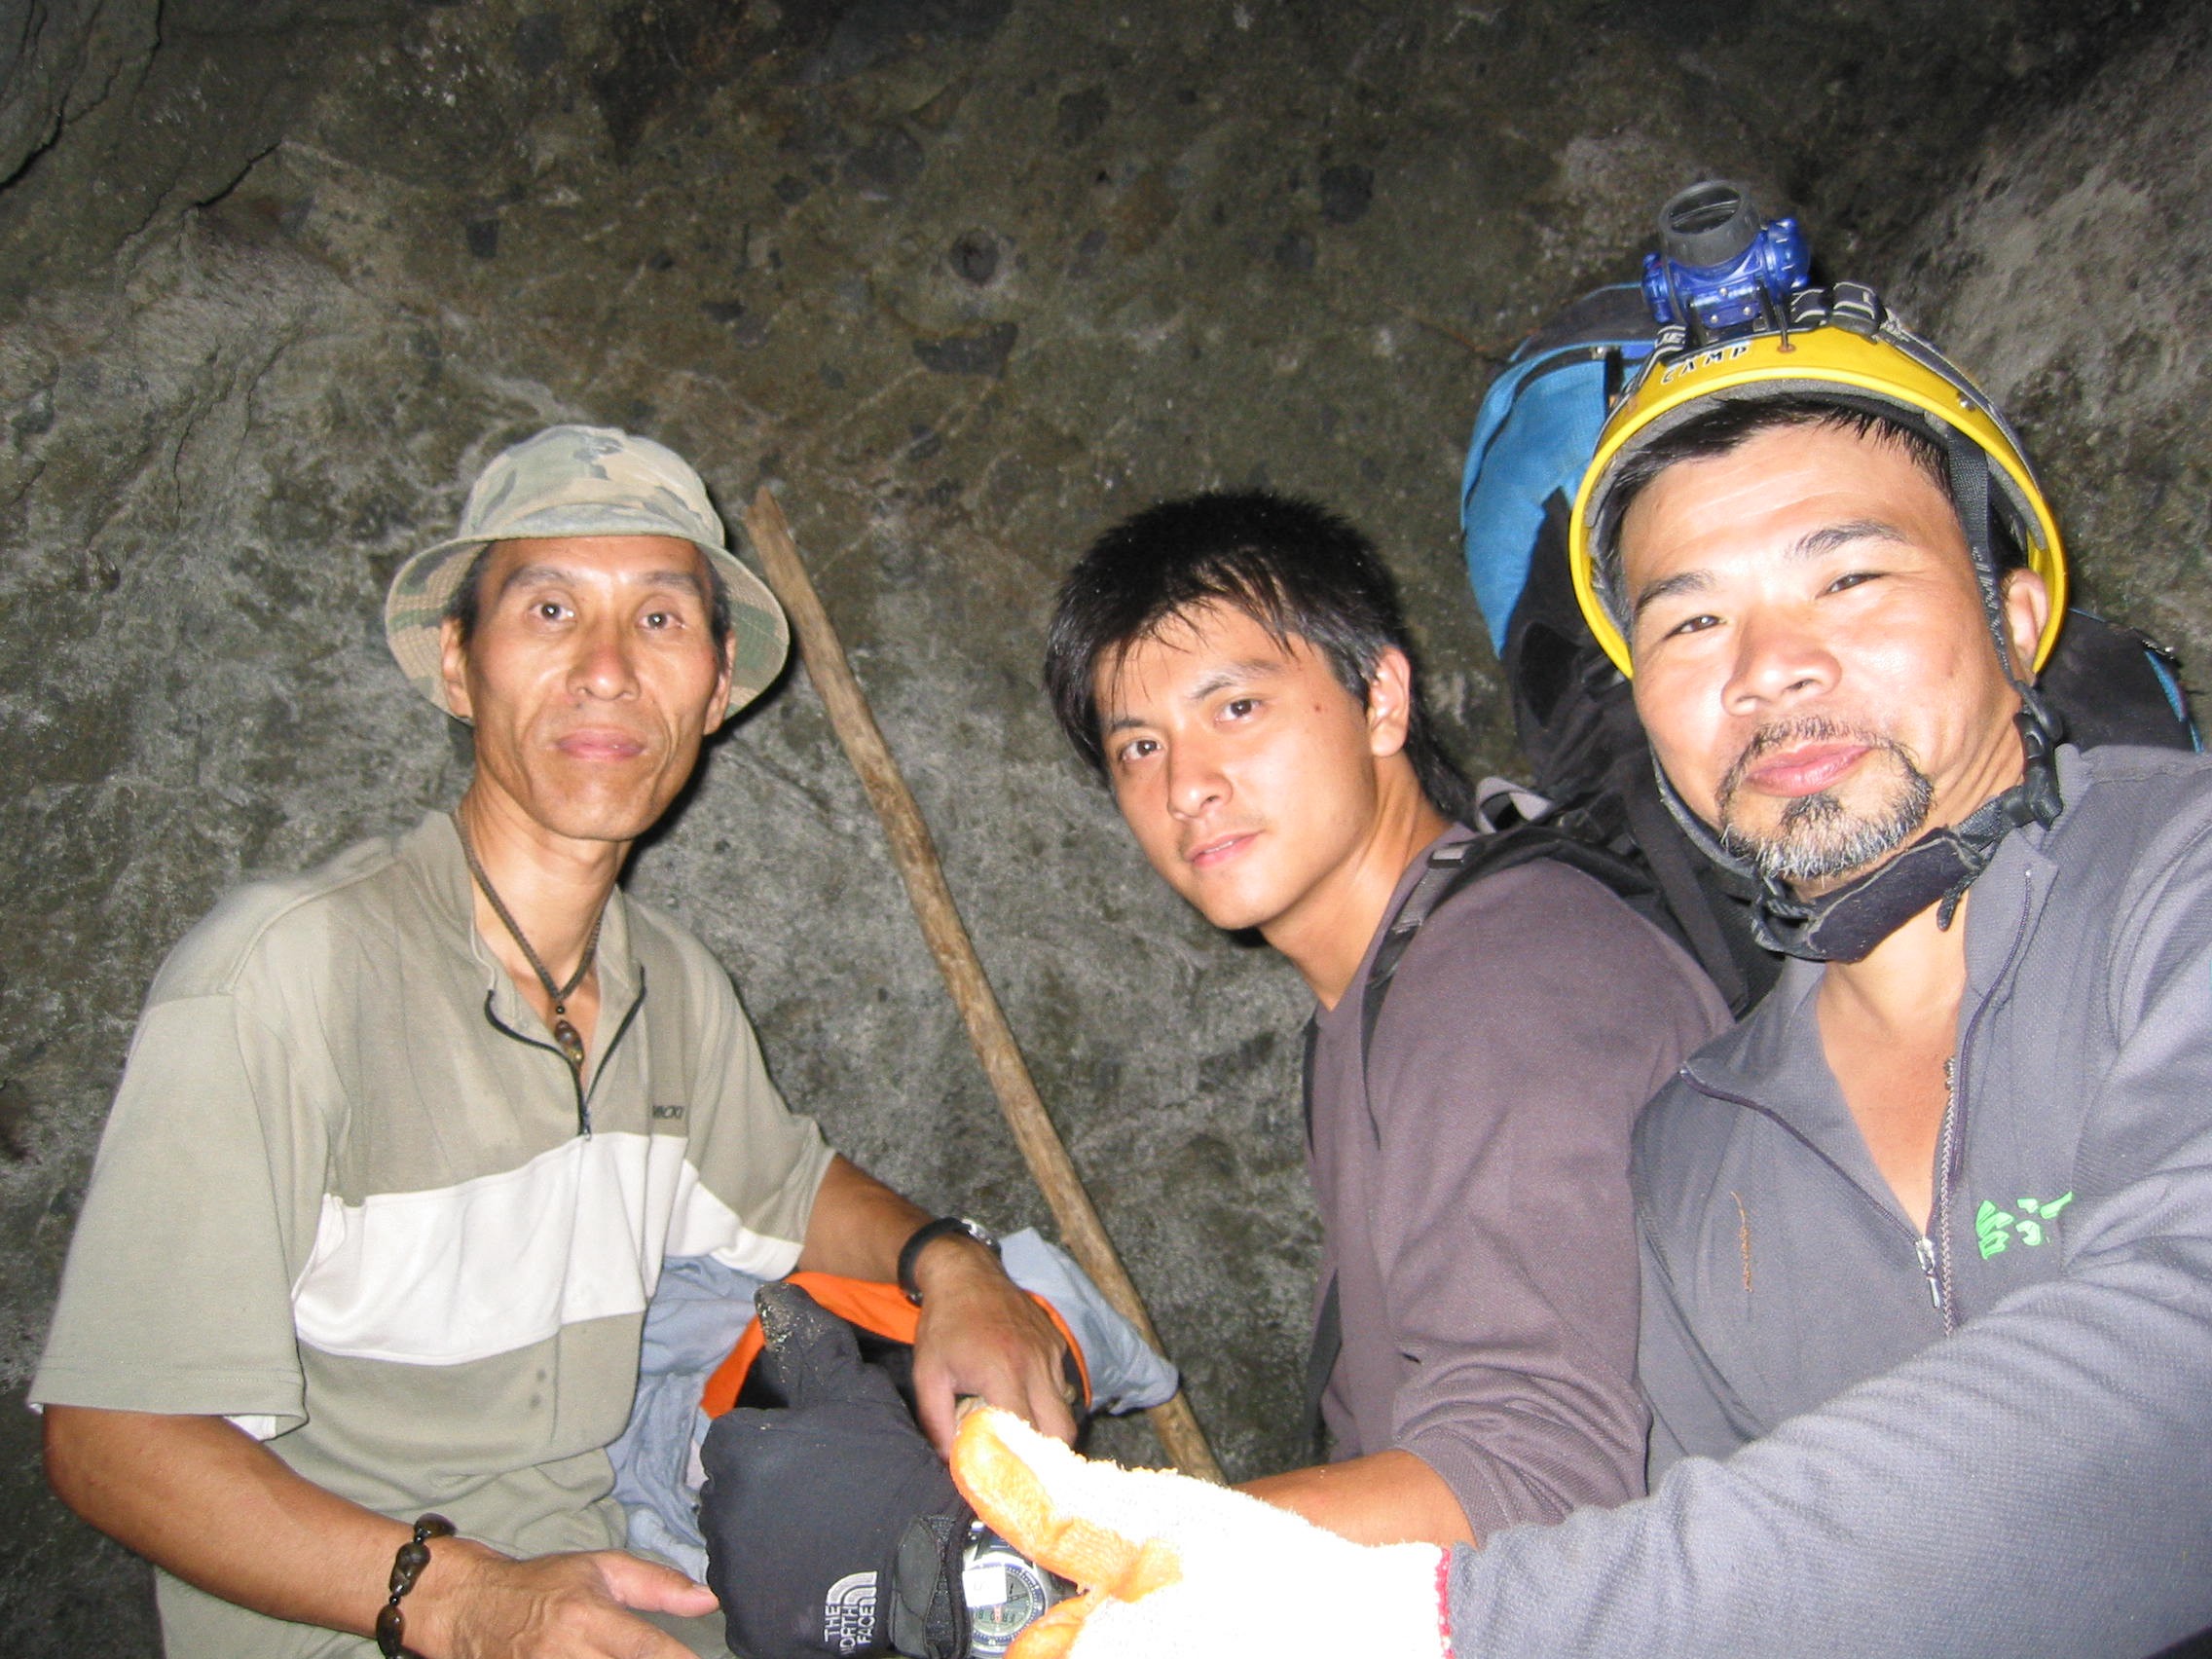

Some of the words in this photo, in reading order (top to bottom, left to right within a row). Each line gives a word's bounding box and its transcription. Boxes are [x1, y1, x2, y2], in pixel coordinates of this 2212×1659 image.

[1662, 344, 1749, 385] CAMP
[825, 1605, 840, 1642] THE
[839, 1605, 858, 1655] NORTH
[857, 1605, 876, 1644] FACE
